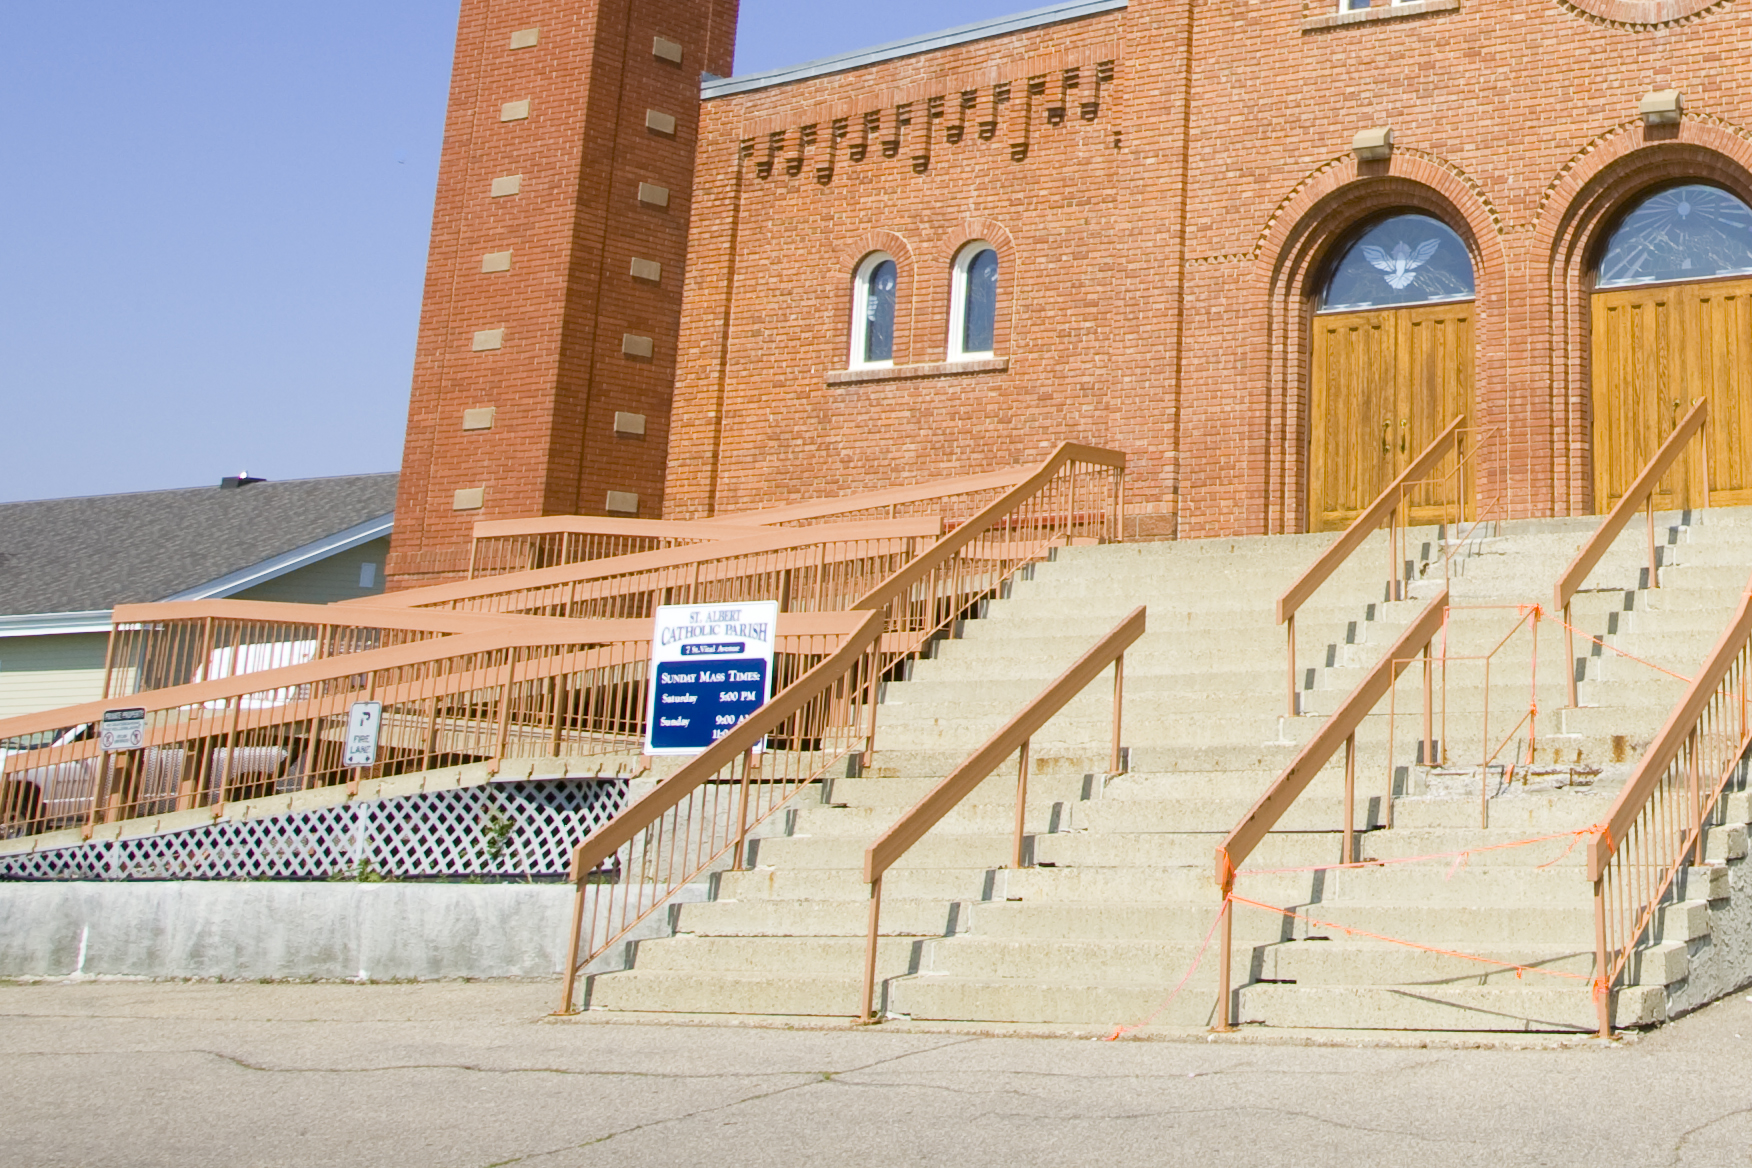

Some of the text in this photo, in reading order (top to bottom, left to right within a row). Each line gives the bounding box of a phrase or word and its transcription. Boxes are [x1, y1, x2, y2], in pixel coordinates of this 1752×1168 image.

[689, 609, 742, 624] ST. ALBERT
[661, 622, 768, 646] CATHOLIC PARISH
[661, 690, 757, 705] Saturday 5:00 PM
[660, 715, 690, 728] Sunday
[715, 714, 735, 725] 9:00
[353, 734, 370, 743] FIRE
